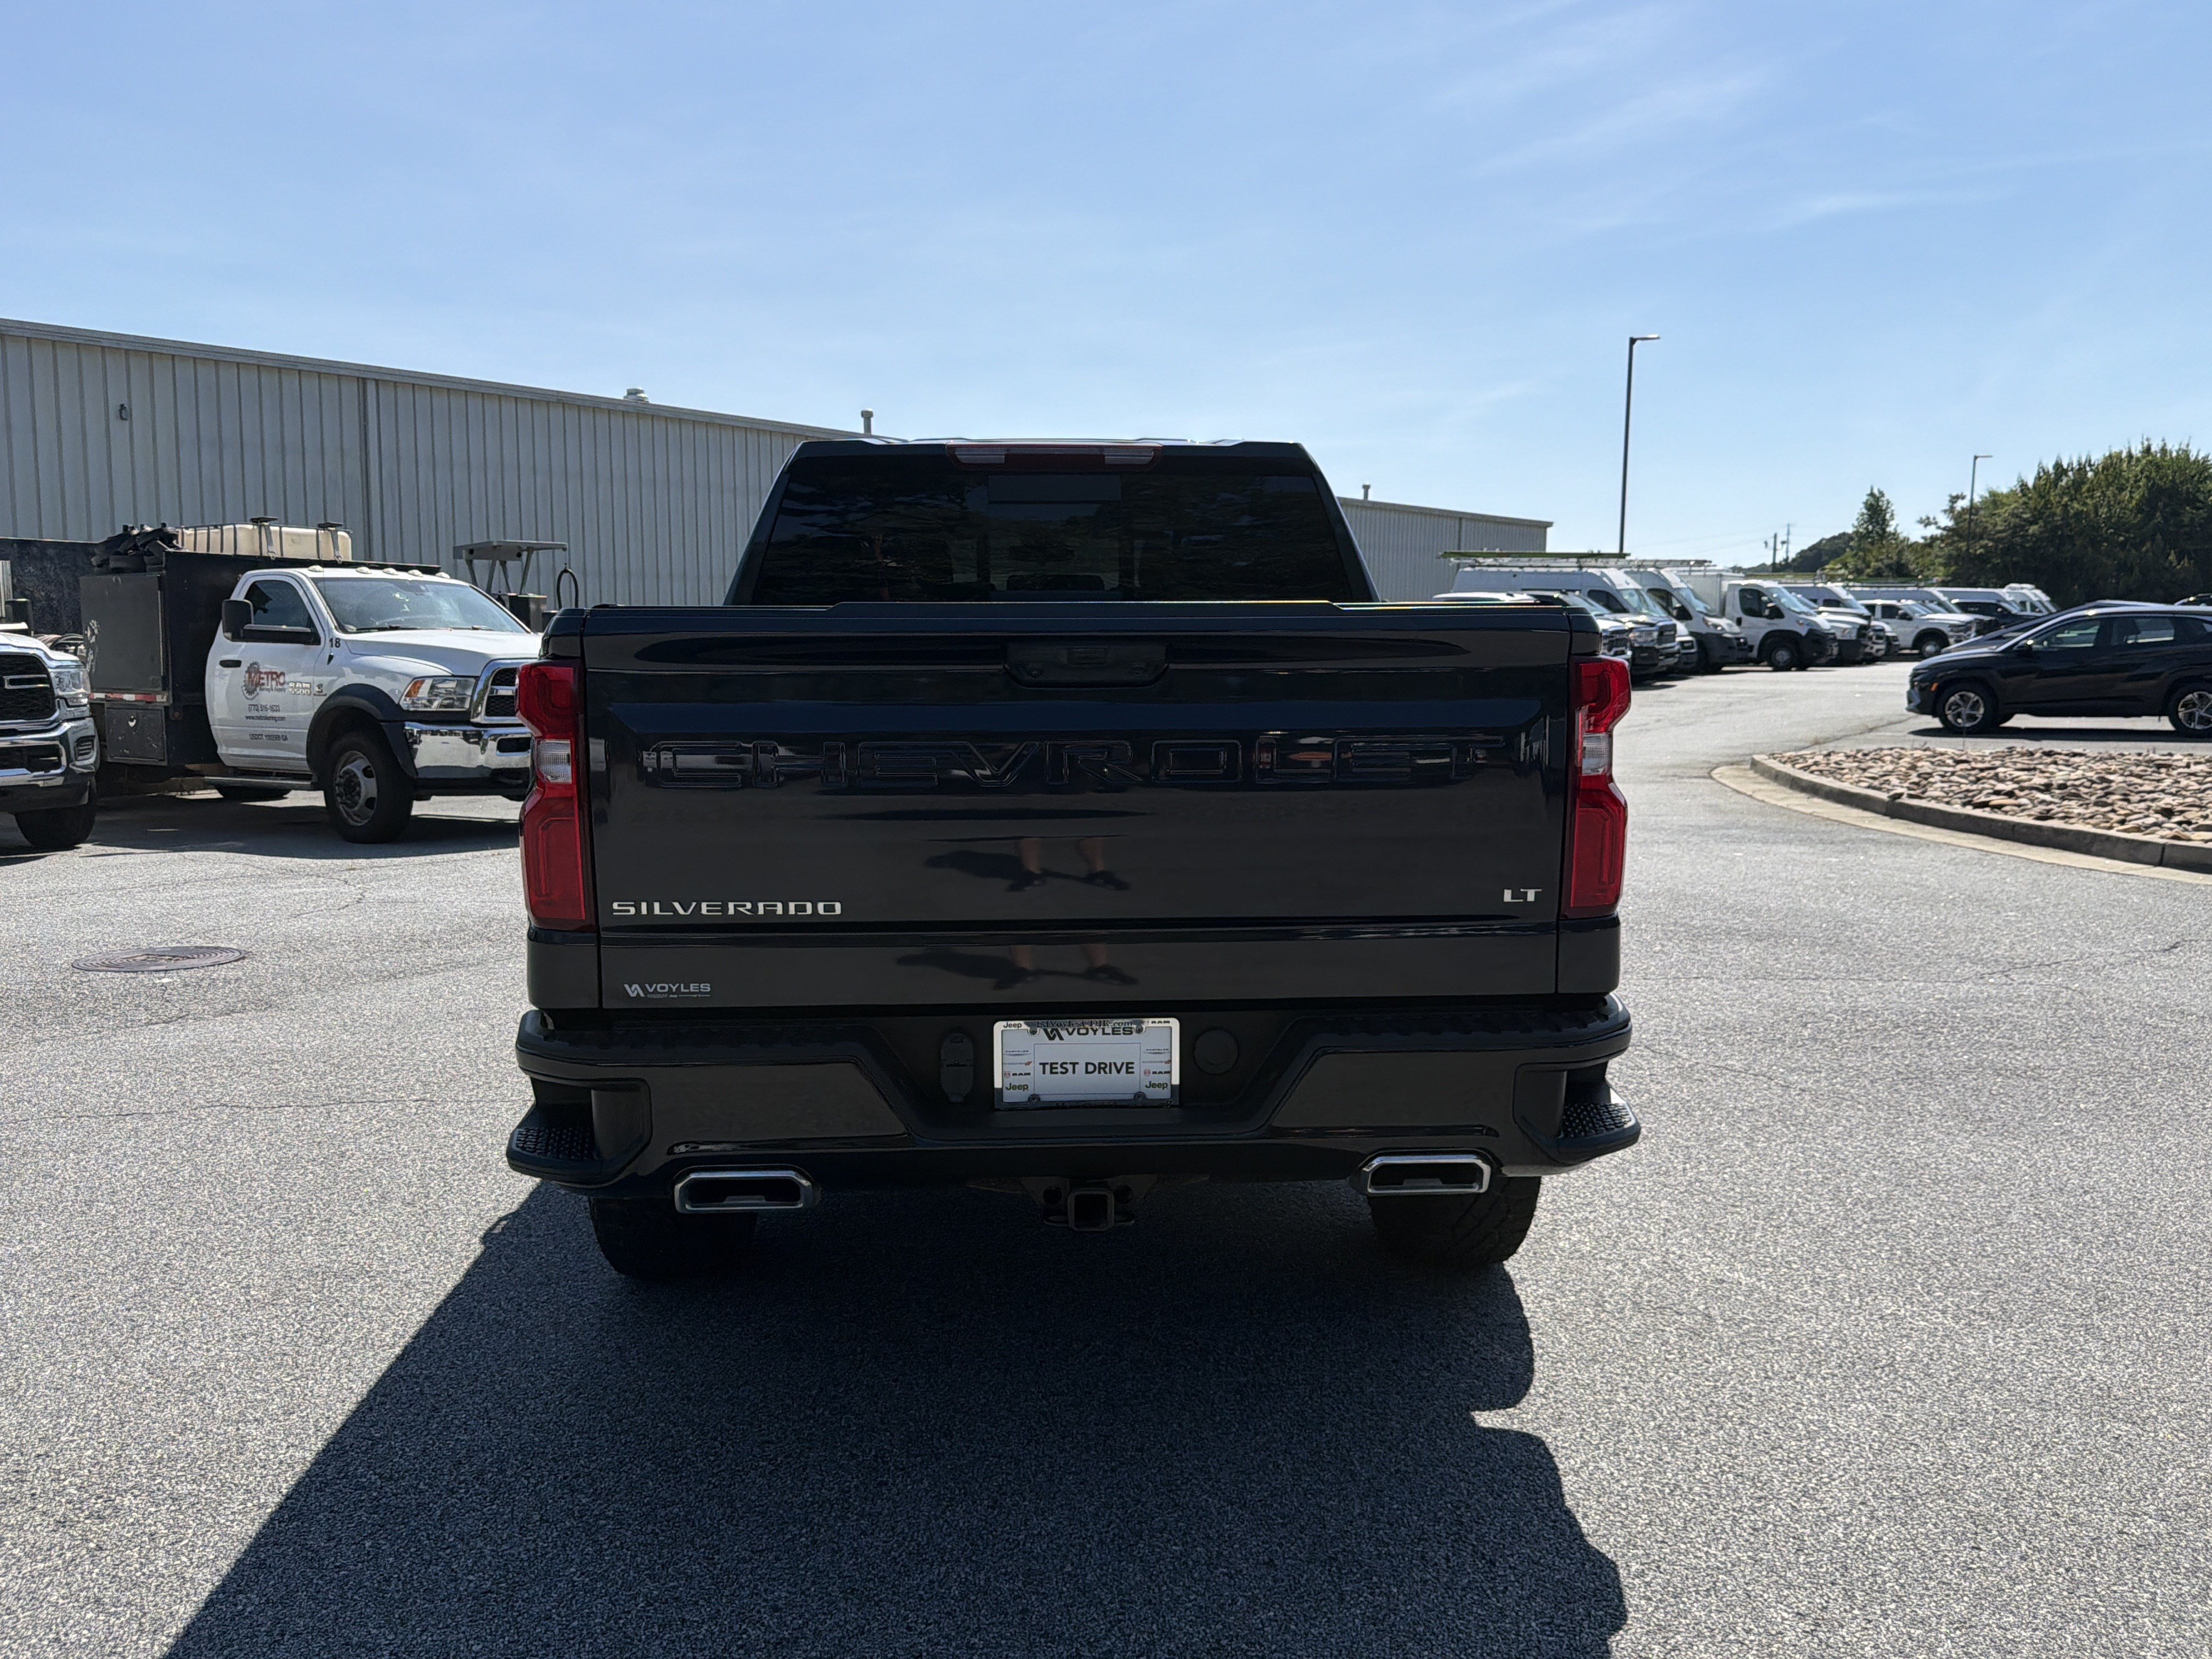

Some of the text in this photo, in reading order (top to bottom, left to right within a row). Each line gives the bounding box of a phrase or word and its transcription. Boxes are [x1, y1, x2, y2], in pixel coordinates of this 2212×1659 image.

[330, 637, 341, 648] 18
[248, 671, 286, 687] METRO
[652, 736, 1505, 788] CHEVROLET
[1503, 888, 1542, 902] LT
[612, 900, 843, 916] SILVERADO
[645, 983, 711, 992] VOYLES
[1067, 1027, 1133, 1036] VOYLES
[1039, 1061, 1135, 1074] TEST DRIVE
[1005, 1082, 1029, 1092] Jeep
[1145, 1080, 1168, 1090] Jeep
